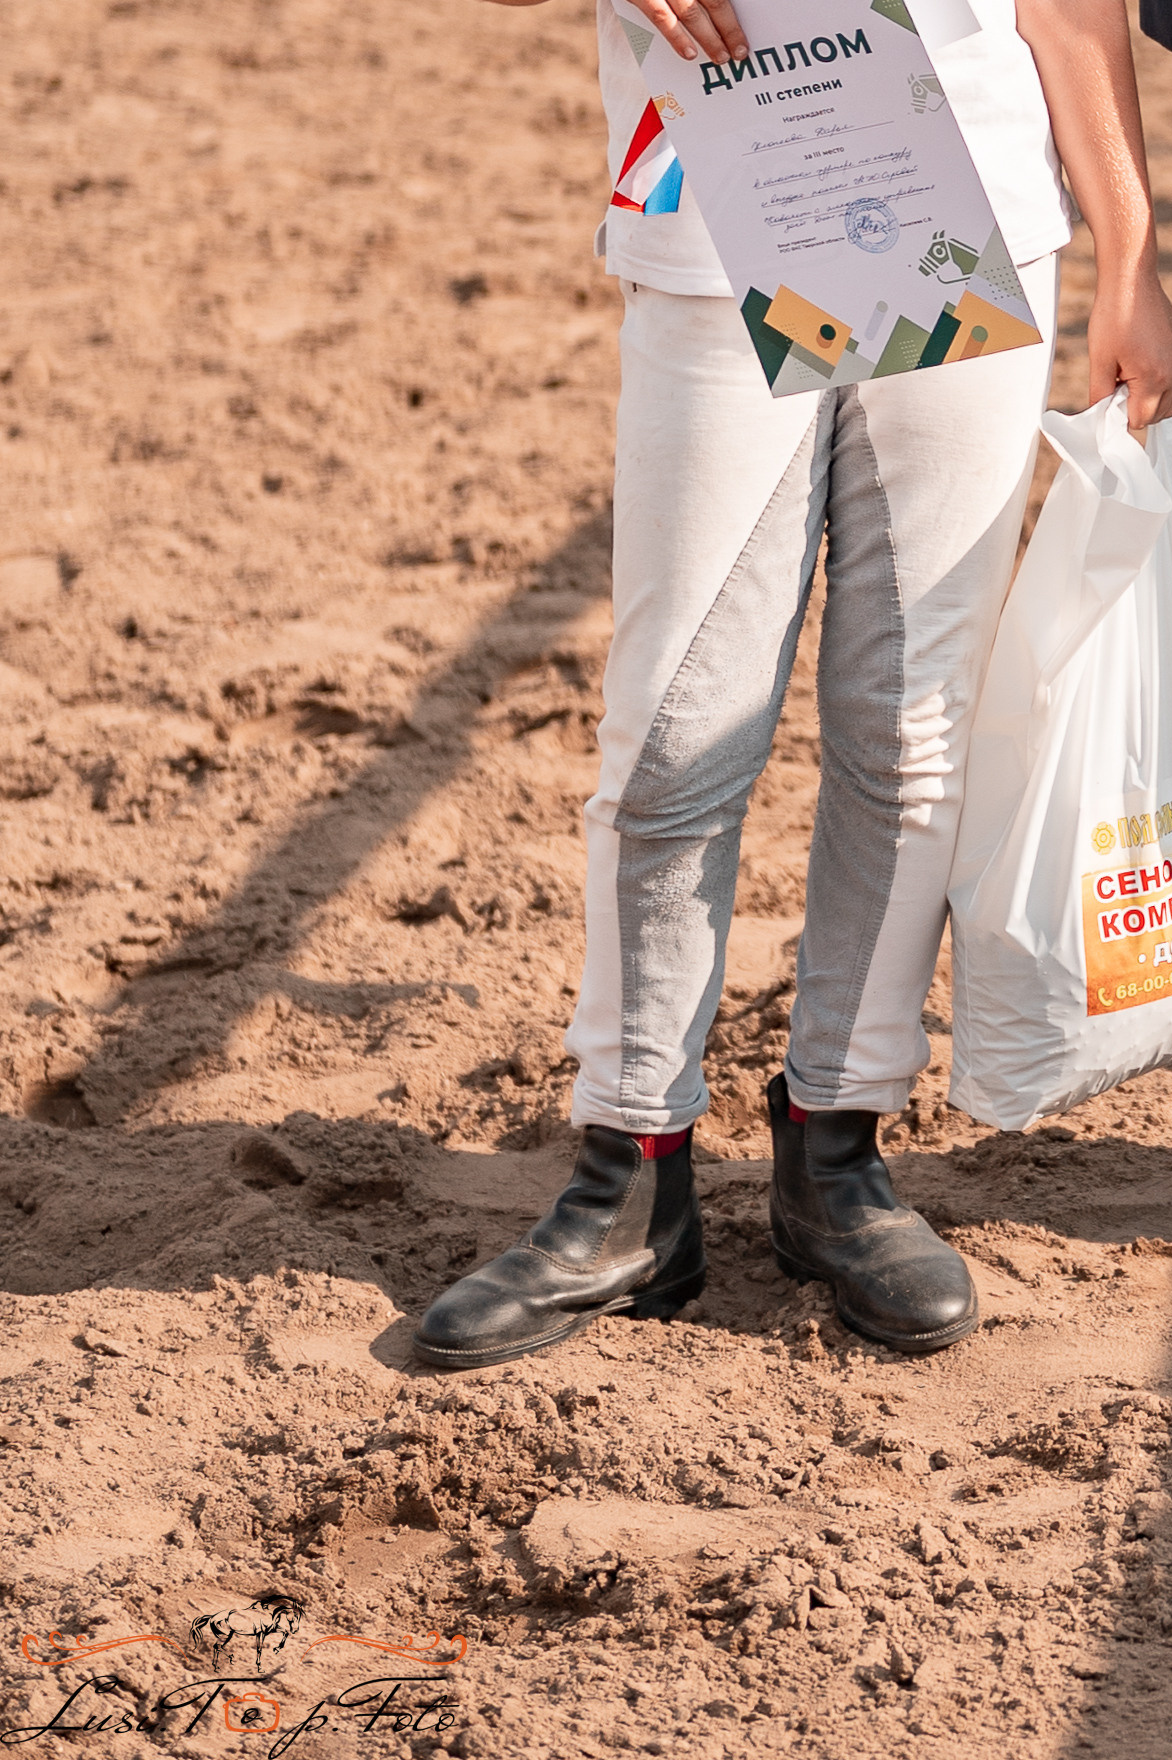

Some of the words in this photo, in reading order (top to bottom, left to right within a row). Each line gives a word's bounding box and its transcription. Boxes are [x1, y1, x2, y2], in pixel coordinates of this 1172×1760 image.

[700, 28, 873, 96] ДИПЛОМ
[755, 92, 772, 106] III
[776, 78, 843, 101] степени
[823, 147, 845, 157] место
